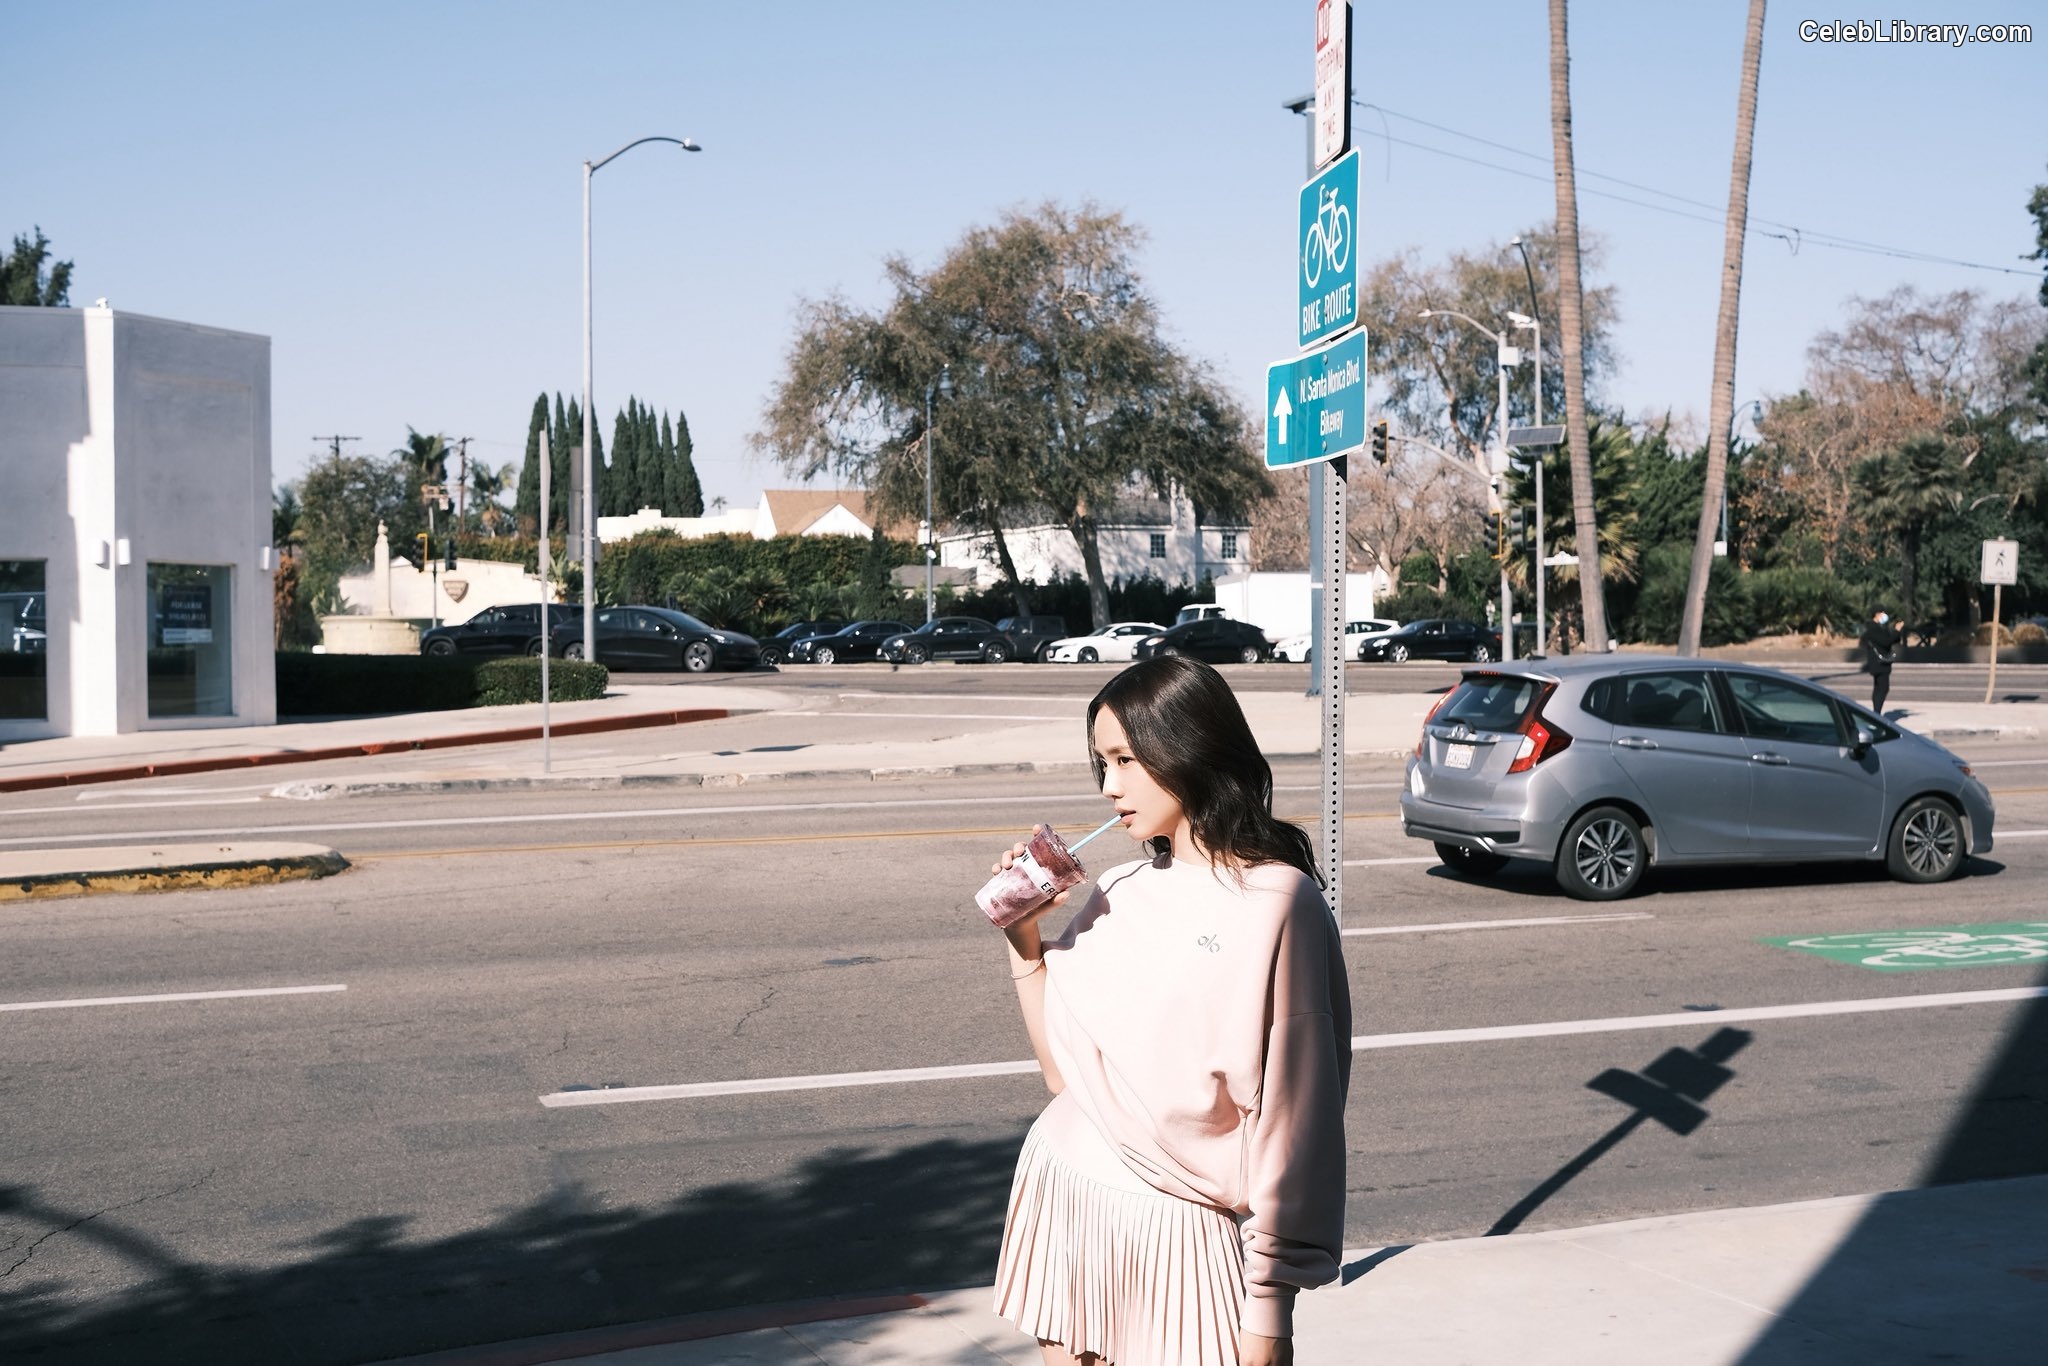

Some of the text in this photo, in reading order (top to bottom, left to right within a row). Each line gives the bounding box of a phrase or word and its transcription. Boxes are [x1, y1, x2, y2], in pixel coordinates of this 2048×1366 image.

[1318, 2, 1329, 45] NO
[1303, 282, 1352, 336] BIKE ROUTE
[1300, 378, 1306, 404] N.
[1307, 373, 1327, 402] Santa
[1327, 364, 1346, 395] Monica
[1320, 409, 1344, 438] Bikeway
